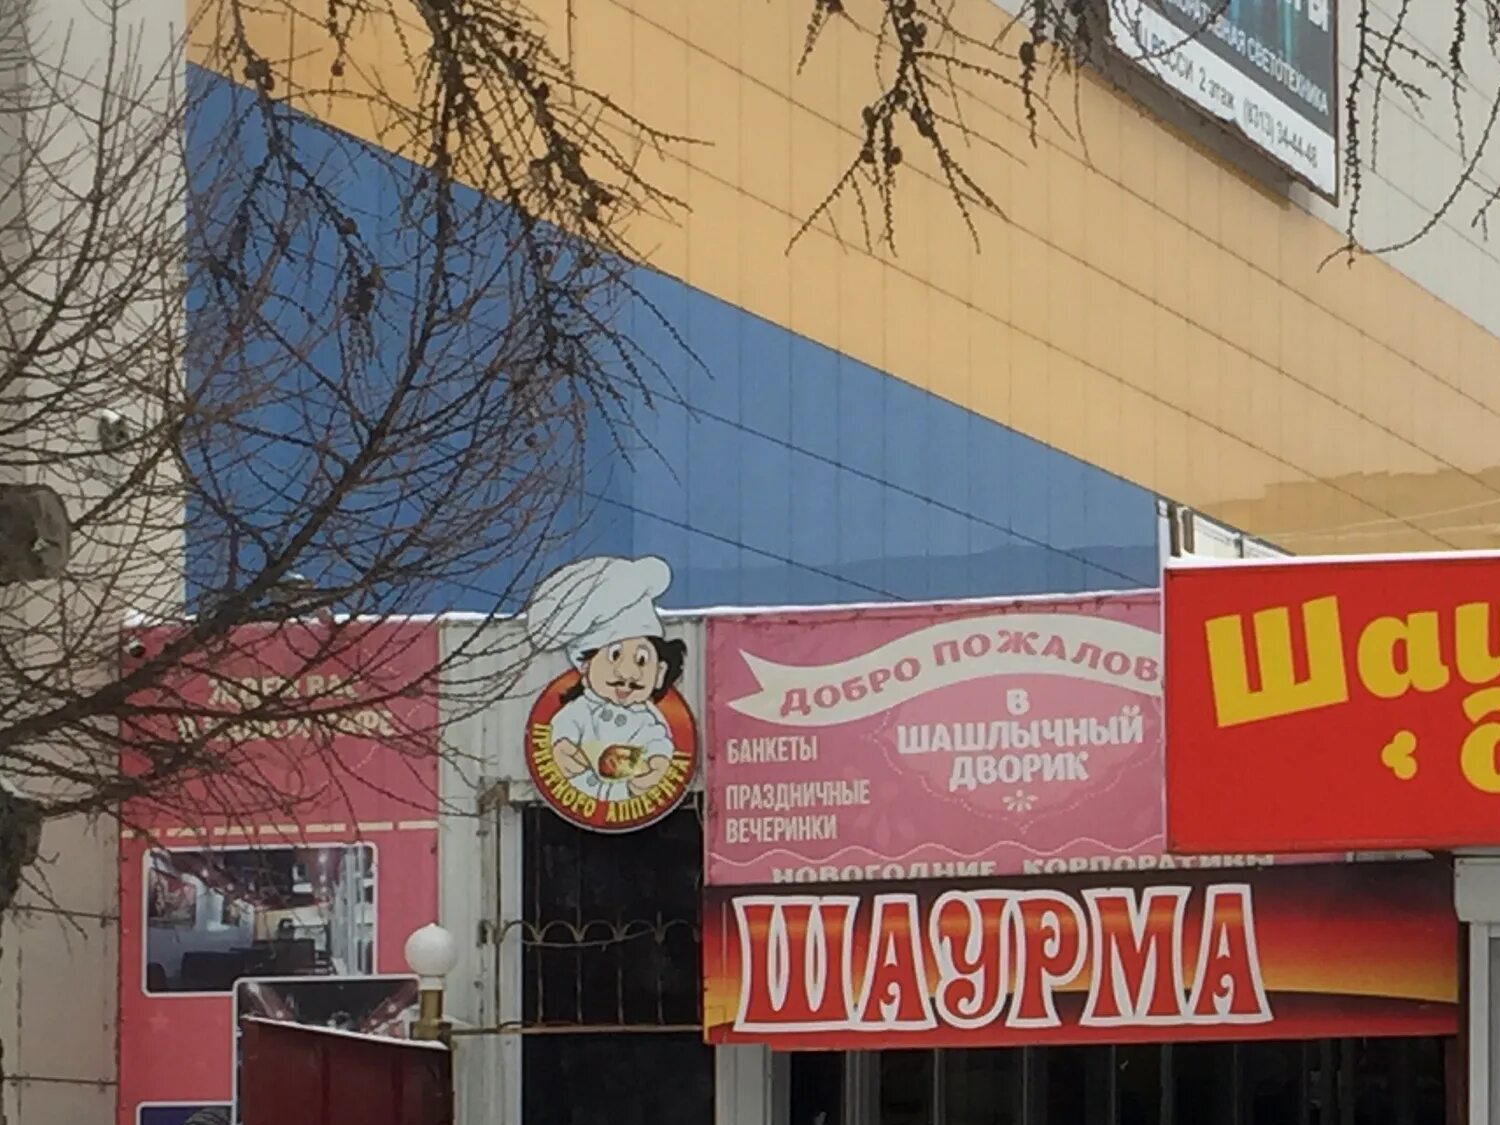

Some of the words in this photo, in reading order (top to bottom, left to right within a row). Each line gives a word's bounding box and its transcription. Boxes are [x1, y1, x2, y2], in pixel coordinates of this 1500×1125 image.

[779, 656, 922, 718] ДОБРО
[1006, 688, 1030, 715] В
[726, 735, 818, 764] БАНКЕТЫ
[898, 704, 1144, 755] ШАШЛЫЧНЫЙ
[531, 722, 597, 818] ПРИЯТНОГО
[949, 751, 1090, 791] ДВОРИК
[725, 779, 871, 812] ПРАЗДНИЧНЫЕ
[726, 814, 837, 844] ВЕЧЕРИНКИ
[733, 884, 1273, 1032] ШАУРМА
